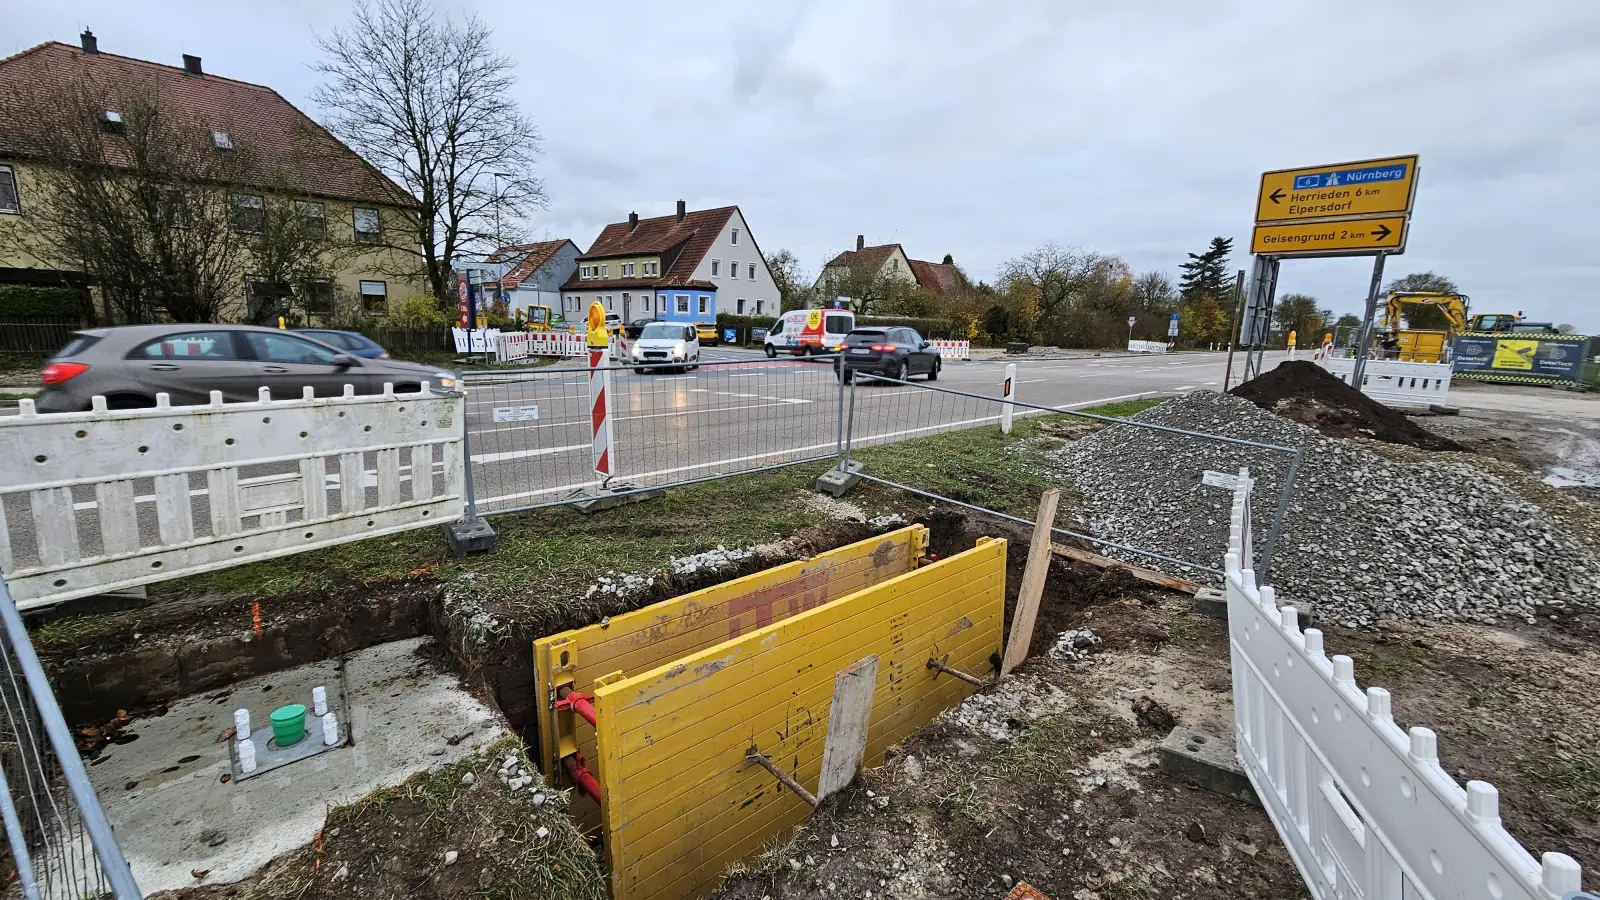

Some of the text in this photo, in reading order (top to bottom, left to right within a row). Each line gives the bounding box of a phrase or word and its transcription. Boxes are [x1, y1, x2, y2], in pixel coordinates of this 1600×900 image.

[1305, 169, 1402, 186] 6 Nürnberg
[1290, 187, 1380, 203] Herrieden 6 km
[1289, 201, 1353, 215] Elpersdorf
[1263, 231, 1365, 244] Geisengrund 2 km
